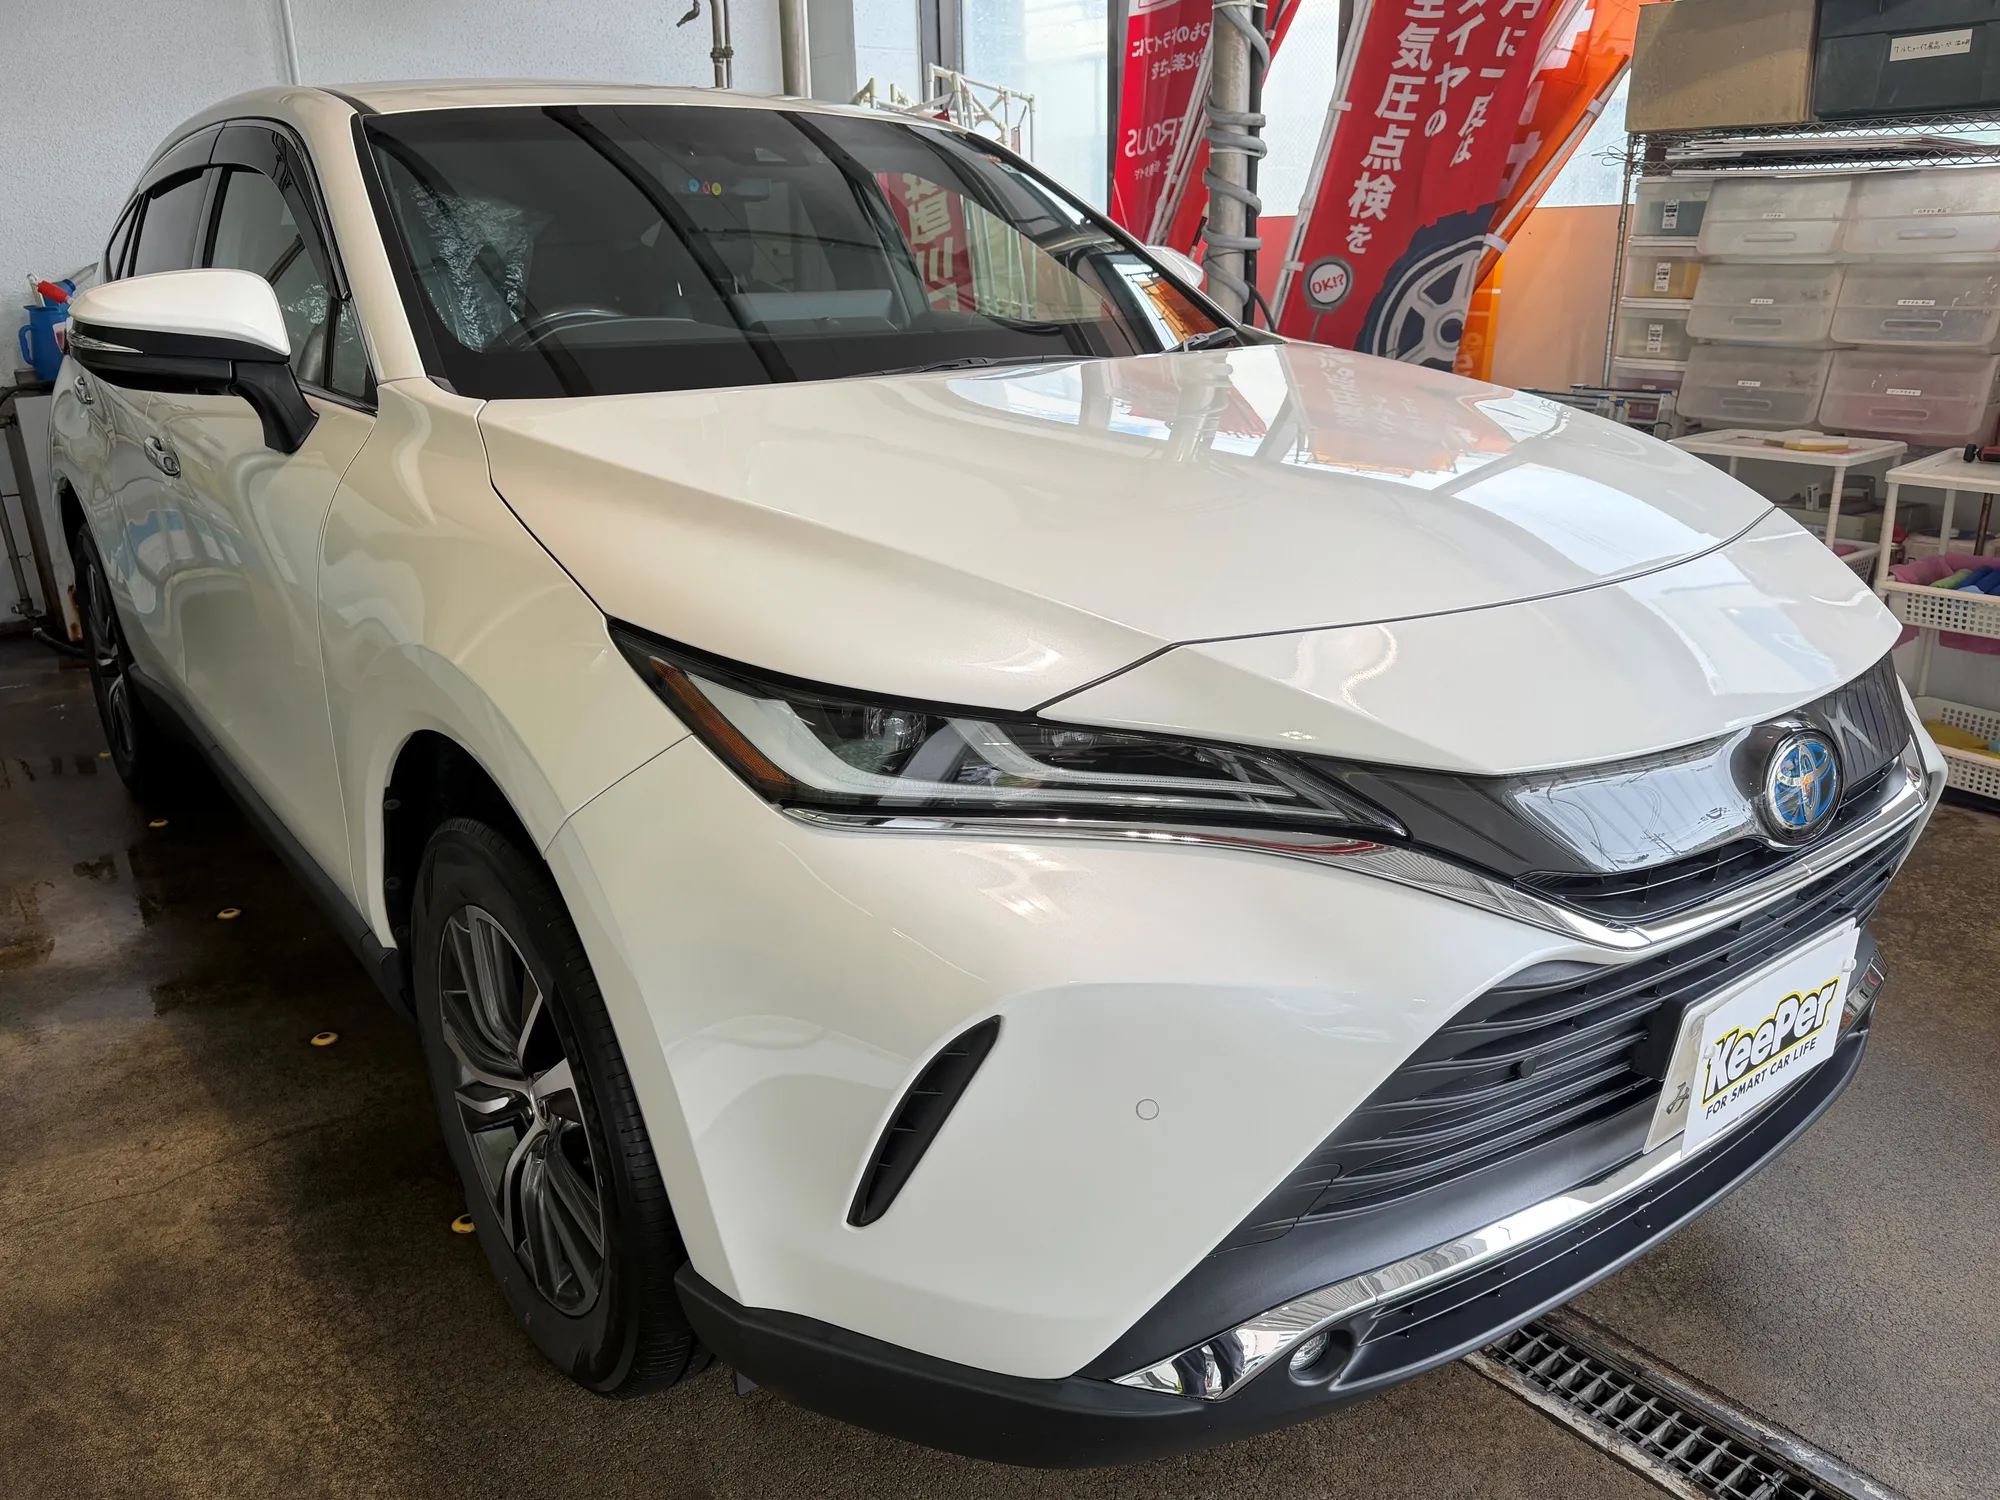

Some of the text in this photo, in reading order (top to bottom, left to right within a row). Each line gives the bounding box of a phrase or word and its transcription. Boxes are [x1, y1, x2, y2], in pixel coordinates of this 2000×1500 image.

[1701, 976, 1841, 1107] KeePer
[1706, 1036, 1817, 1120] FOR SMART CAR LIFE
